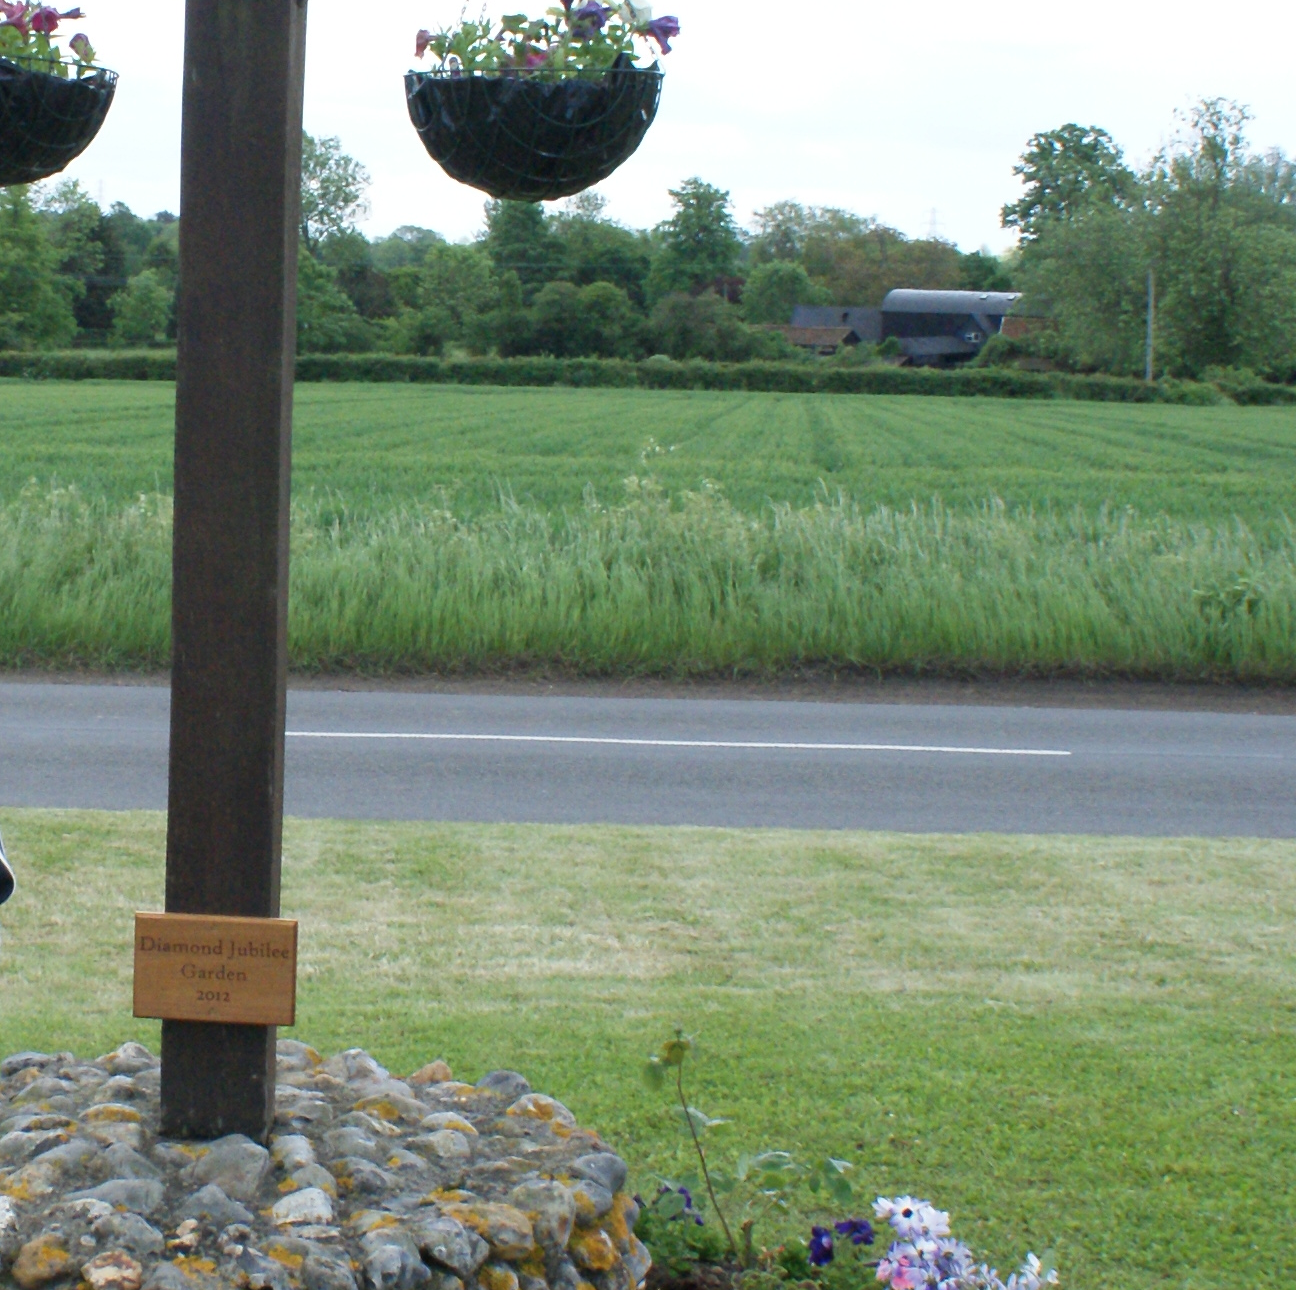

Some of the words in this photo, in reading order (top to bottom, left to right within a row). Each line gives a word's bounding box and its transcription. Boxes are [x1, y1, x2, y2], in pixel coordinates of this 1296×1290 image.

[139, 936, 223, 956] Diamond
[228, 940, 290, 959] Jubilee
[180, 963, 248, 982] Garden
[196, 990, 231, 1002] 2012
